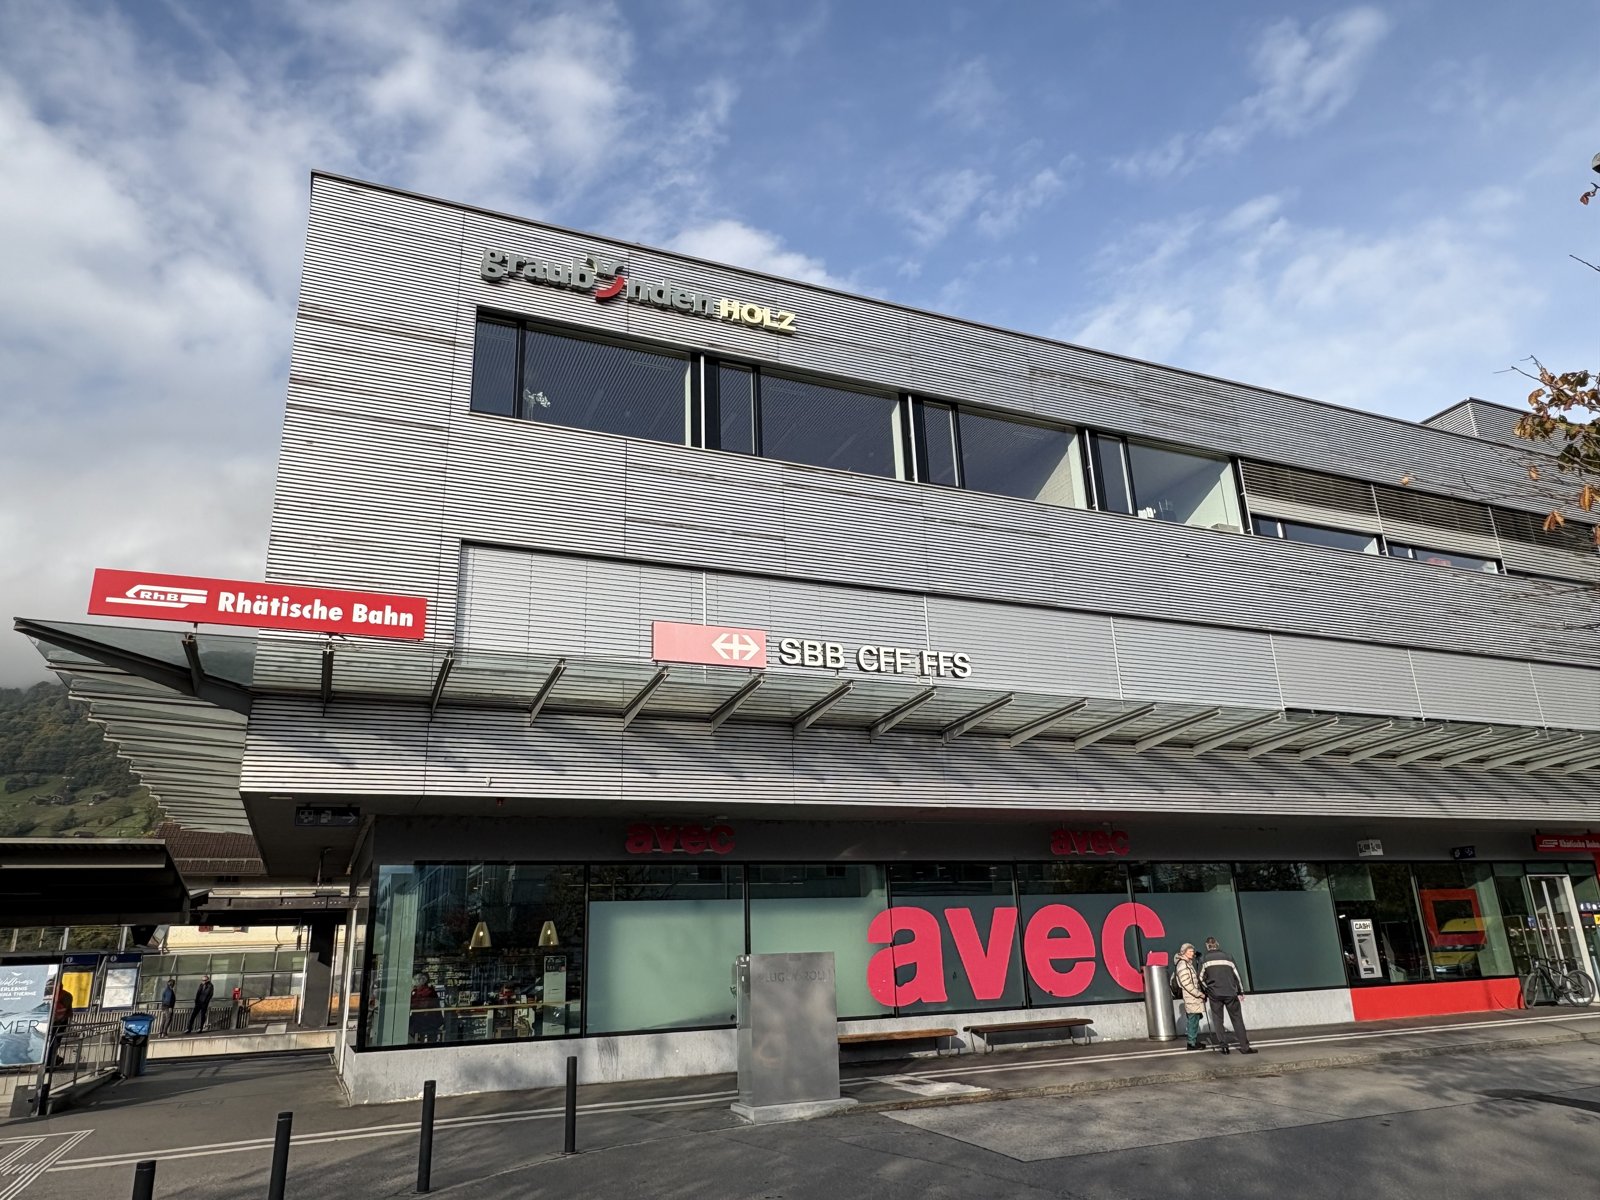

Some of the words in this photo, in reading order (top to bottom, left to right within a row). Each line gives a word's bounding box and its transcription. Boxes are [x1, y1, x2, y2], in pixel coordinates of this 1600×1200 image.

[719, 297, 796, 334] HOLZ
[140, 590, 179, 602] RhB
[217, 591, 344, 621] Rhätische
[351, 603, 414, 628] Bahn
[779, 638, 846, 669] SBB
[856, 645, 912, 674] CFF
[918, 650, 972, 678] FFS
[625, 823, 736, 855] avec
[1050, 829, 1131, 856] avec
[1354, 922, 1371, 930] CASH
[867, 902, 1167, 1007] avec
